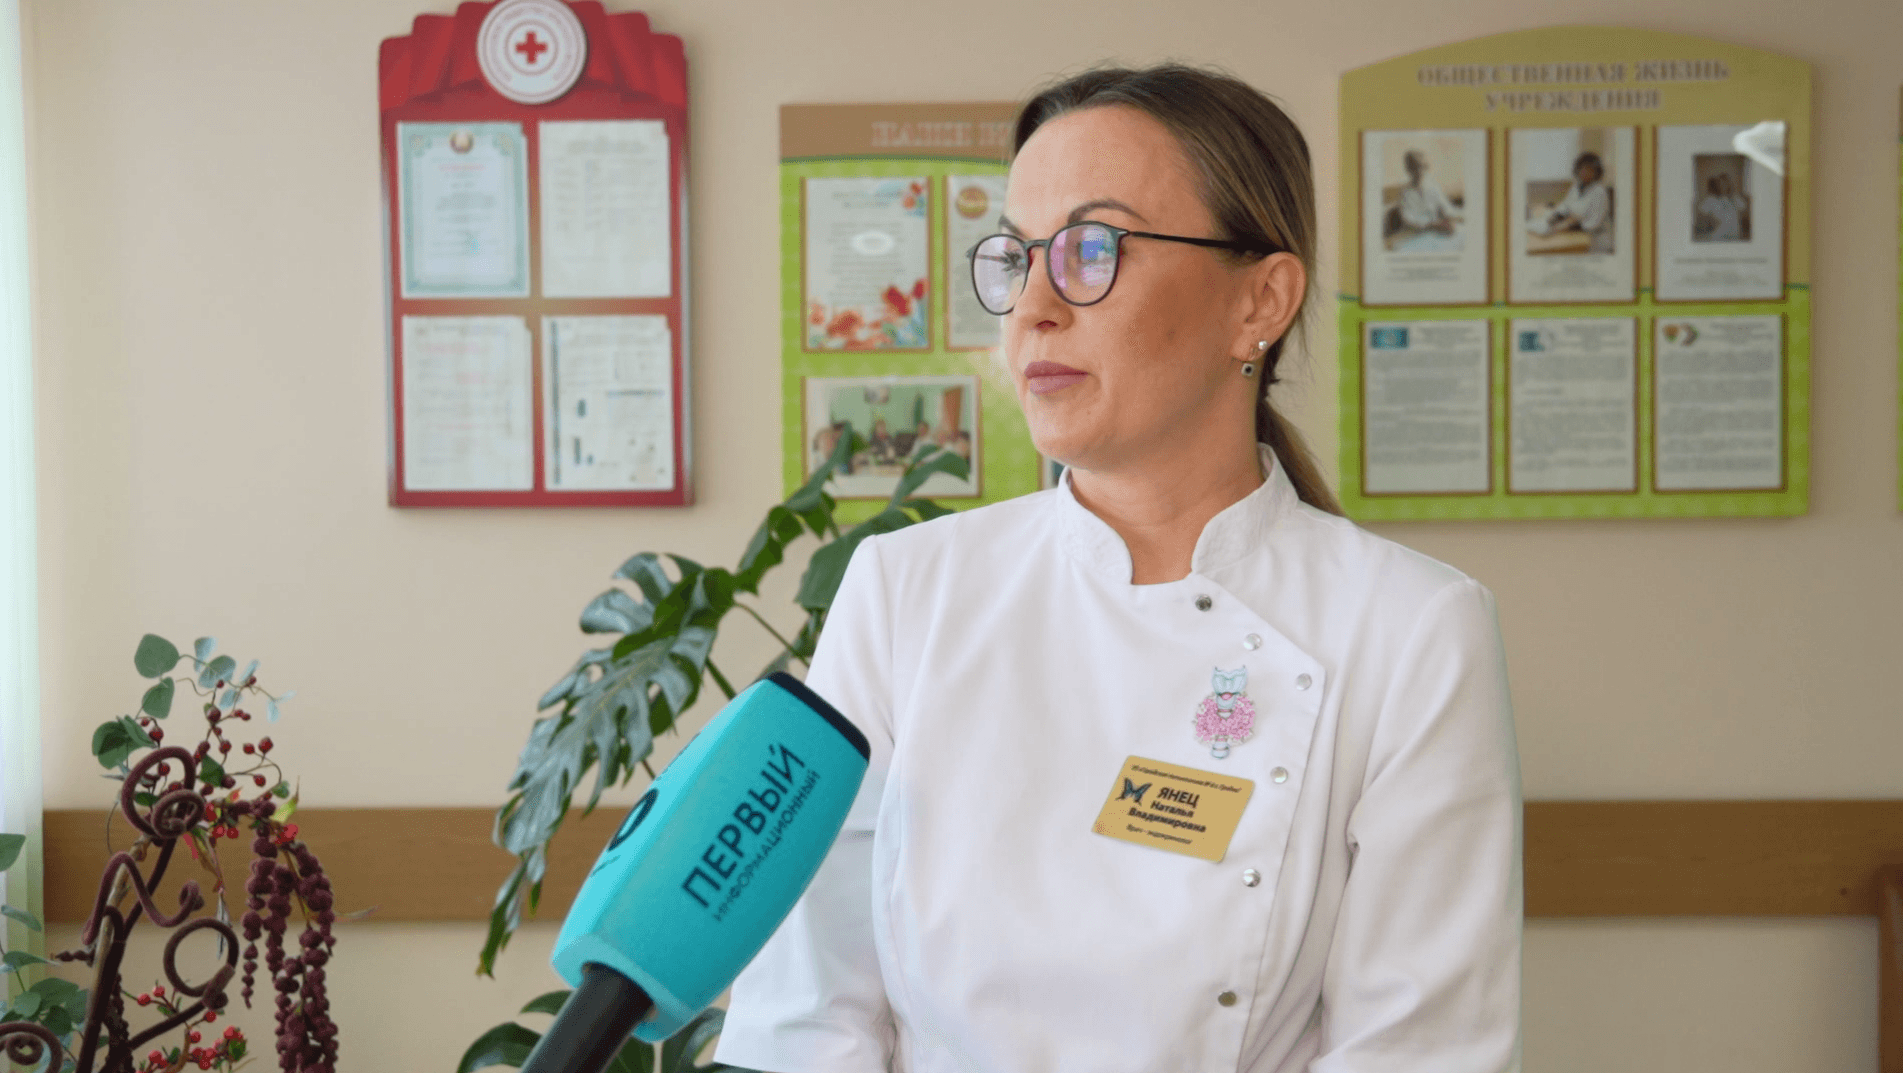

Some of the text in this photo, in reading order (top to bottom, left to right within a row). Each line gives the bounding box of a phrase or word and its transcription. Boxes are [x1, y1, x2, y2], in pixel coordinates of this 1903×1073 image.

[1417, 59, 1730, 87] ОБЩЕСТВЕННАЯ ЖИЗНЬ
[1484, 88, 1662, 111] УЧРЕЖДЕНИЯ
[1150, 800, 1194, 818] Наталья
[1157, 787, 1200, 808] ЯНЕЦ
[681, 743, 805, 909] ПЕРВЫЙ
[1128, 807, 1207, 833] Владимировна
[713, 769, 821, 922] ИНФОРМАЦИОННЫЙ
